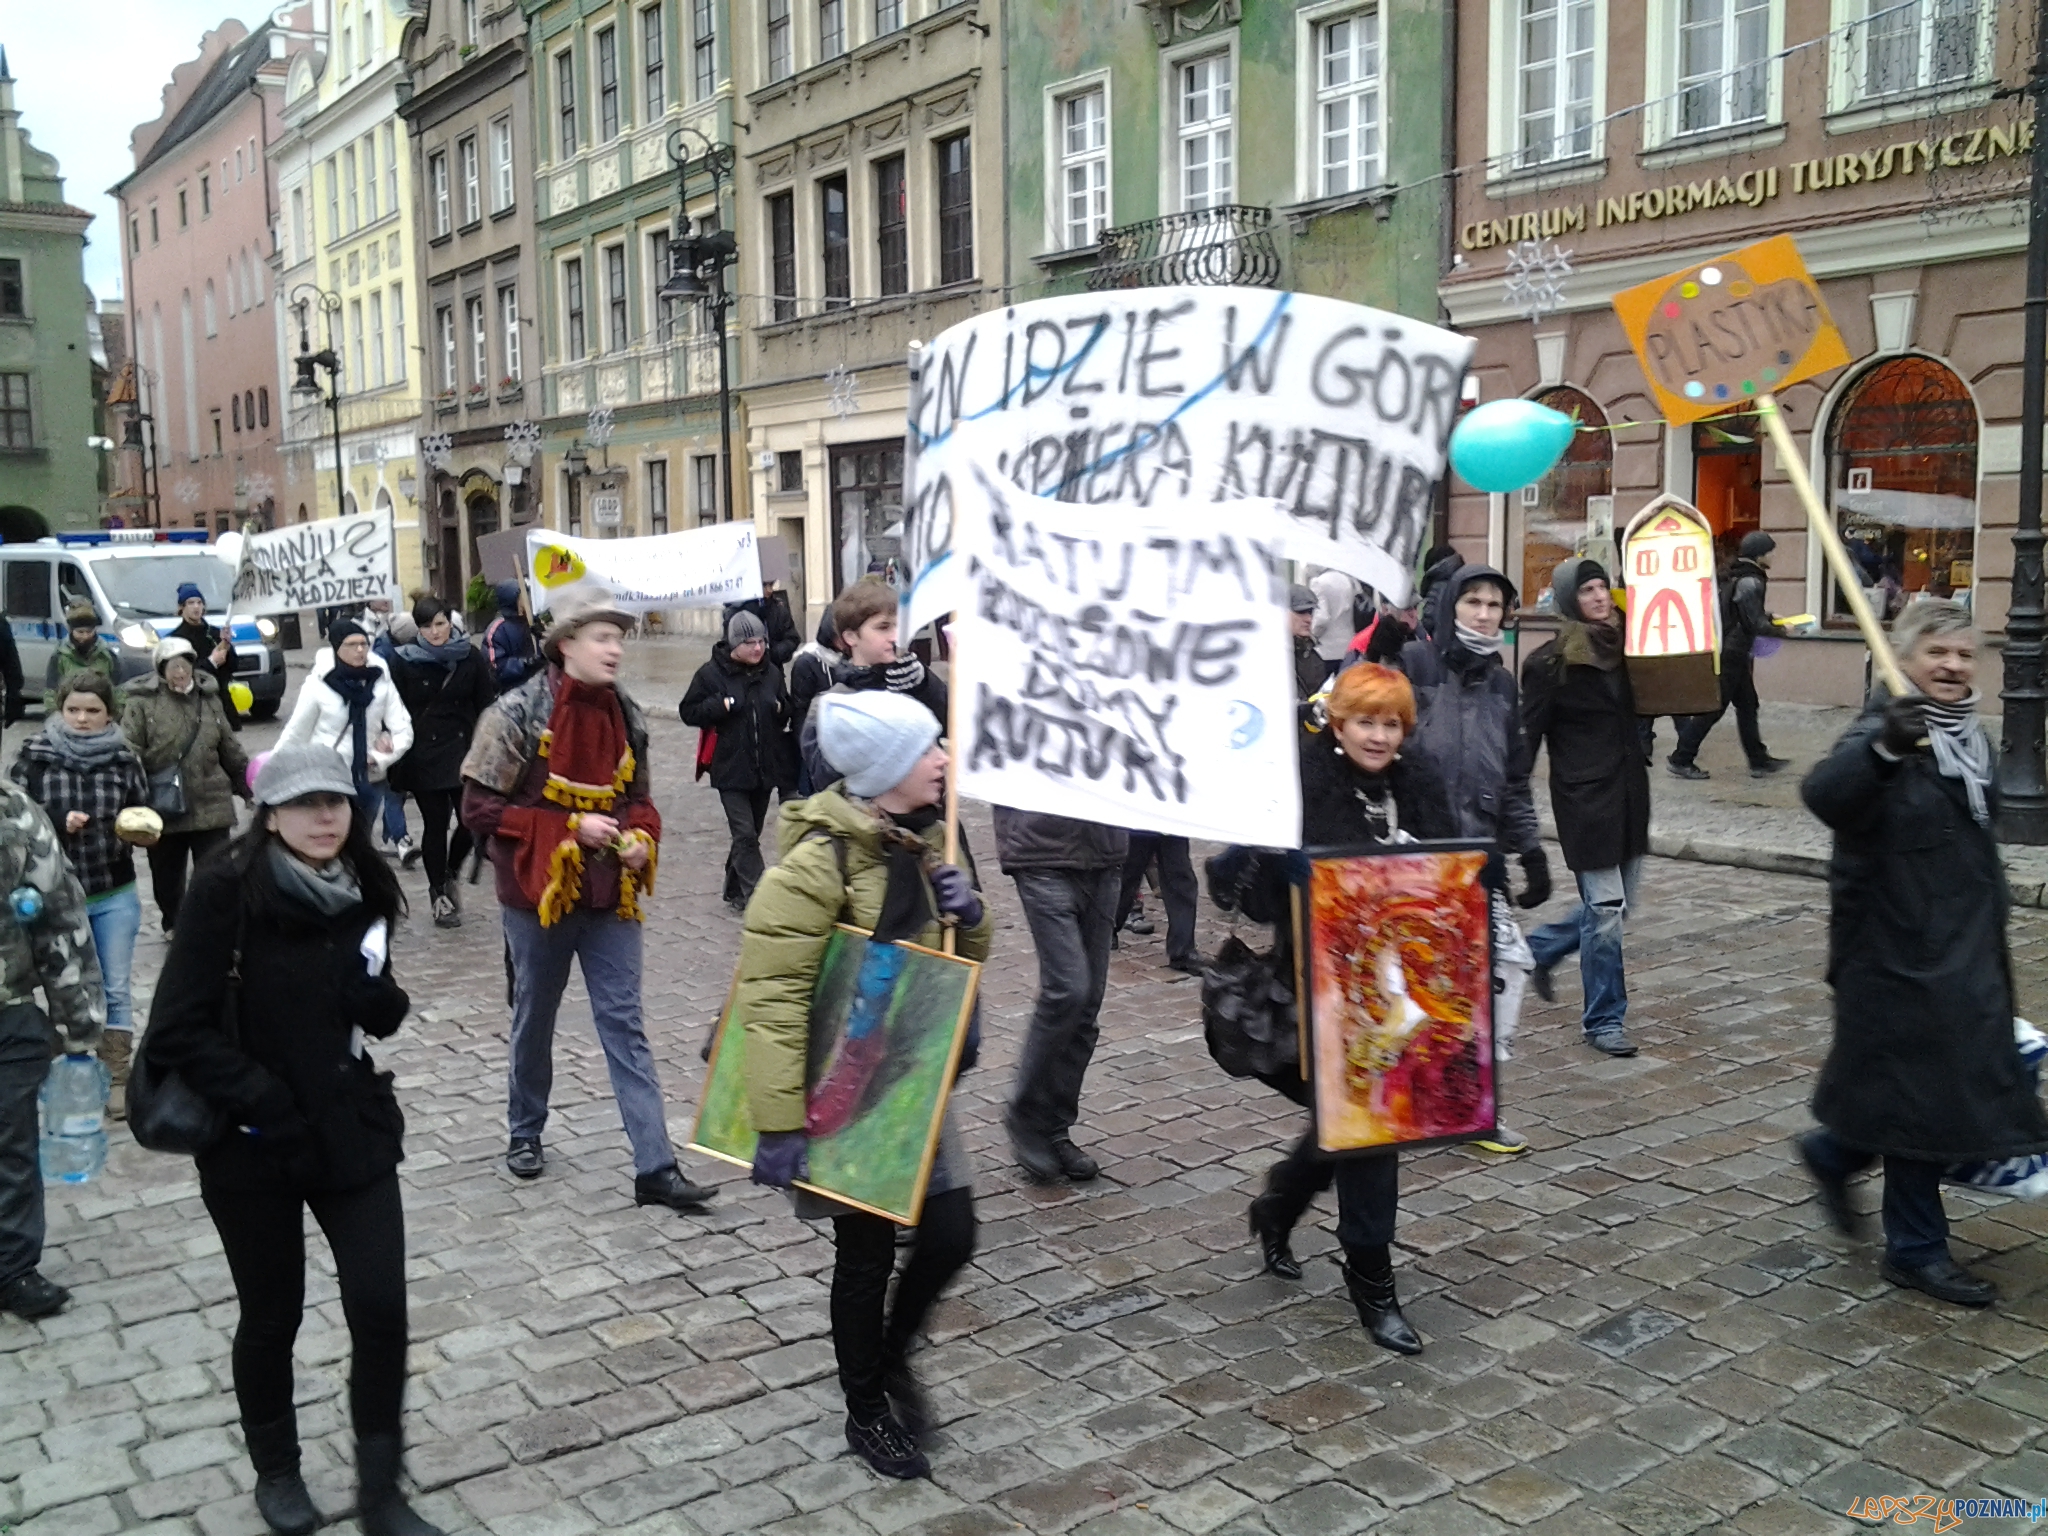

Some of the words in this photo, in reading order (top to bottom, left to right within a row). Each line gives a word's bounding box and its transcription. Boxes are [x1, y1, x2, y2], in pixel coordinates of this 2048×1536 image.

[1461, 203, 1587, 250] CENTRUM
[1596, 166, 1780, 228] INFORMACJI
[1213, 304, 1293, 394] W
[1648, 281, 1818, 384] PLASTYKA
[284, 557, 336, 586] DLA
